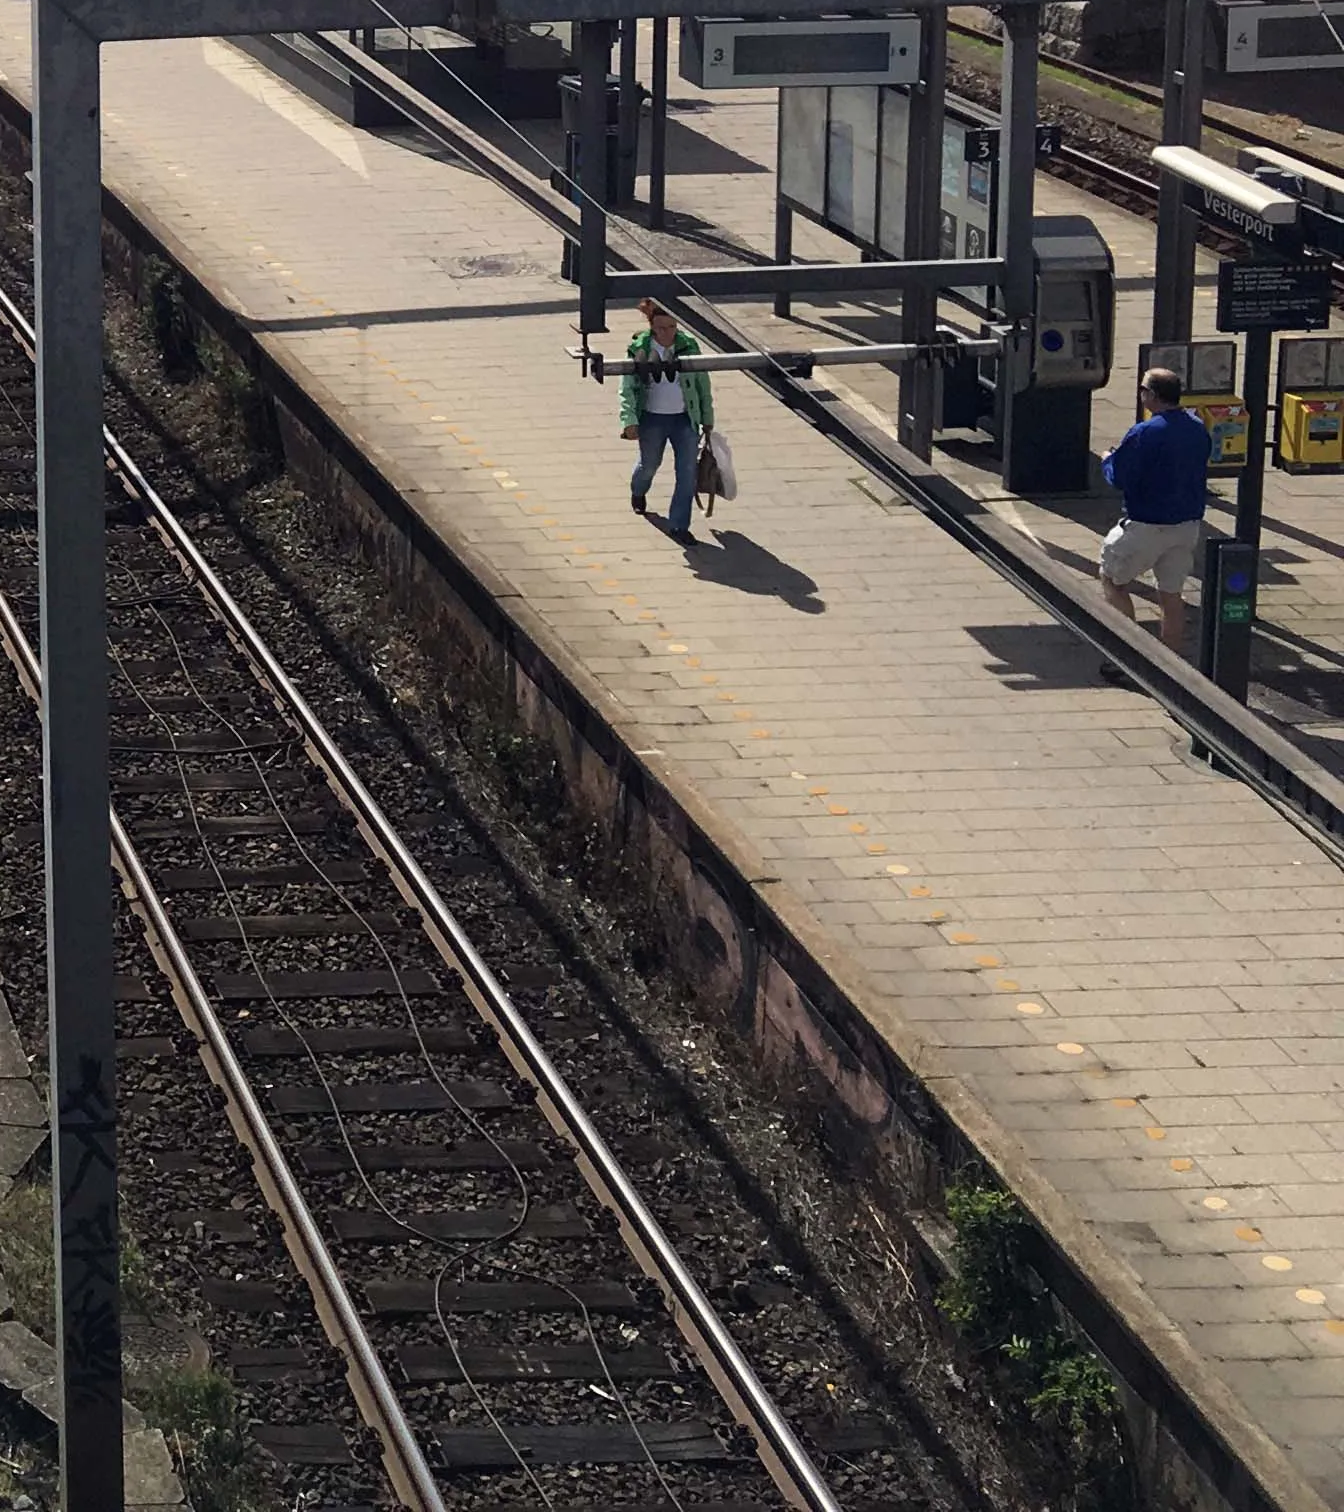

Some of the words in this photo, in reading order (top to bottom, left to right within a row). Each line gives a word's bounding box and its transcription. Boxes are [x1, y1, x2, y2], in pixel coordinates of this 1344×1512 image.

[1237, 32, 1248, 45] 4
[713, 48, 724, 62] 3
[977, 141, 991, 158] 3
[1039, 138, 1052, 154] 4
[1202, 189, 1275, 242] Vesterport
